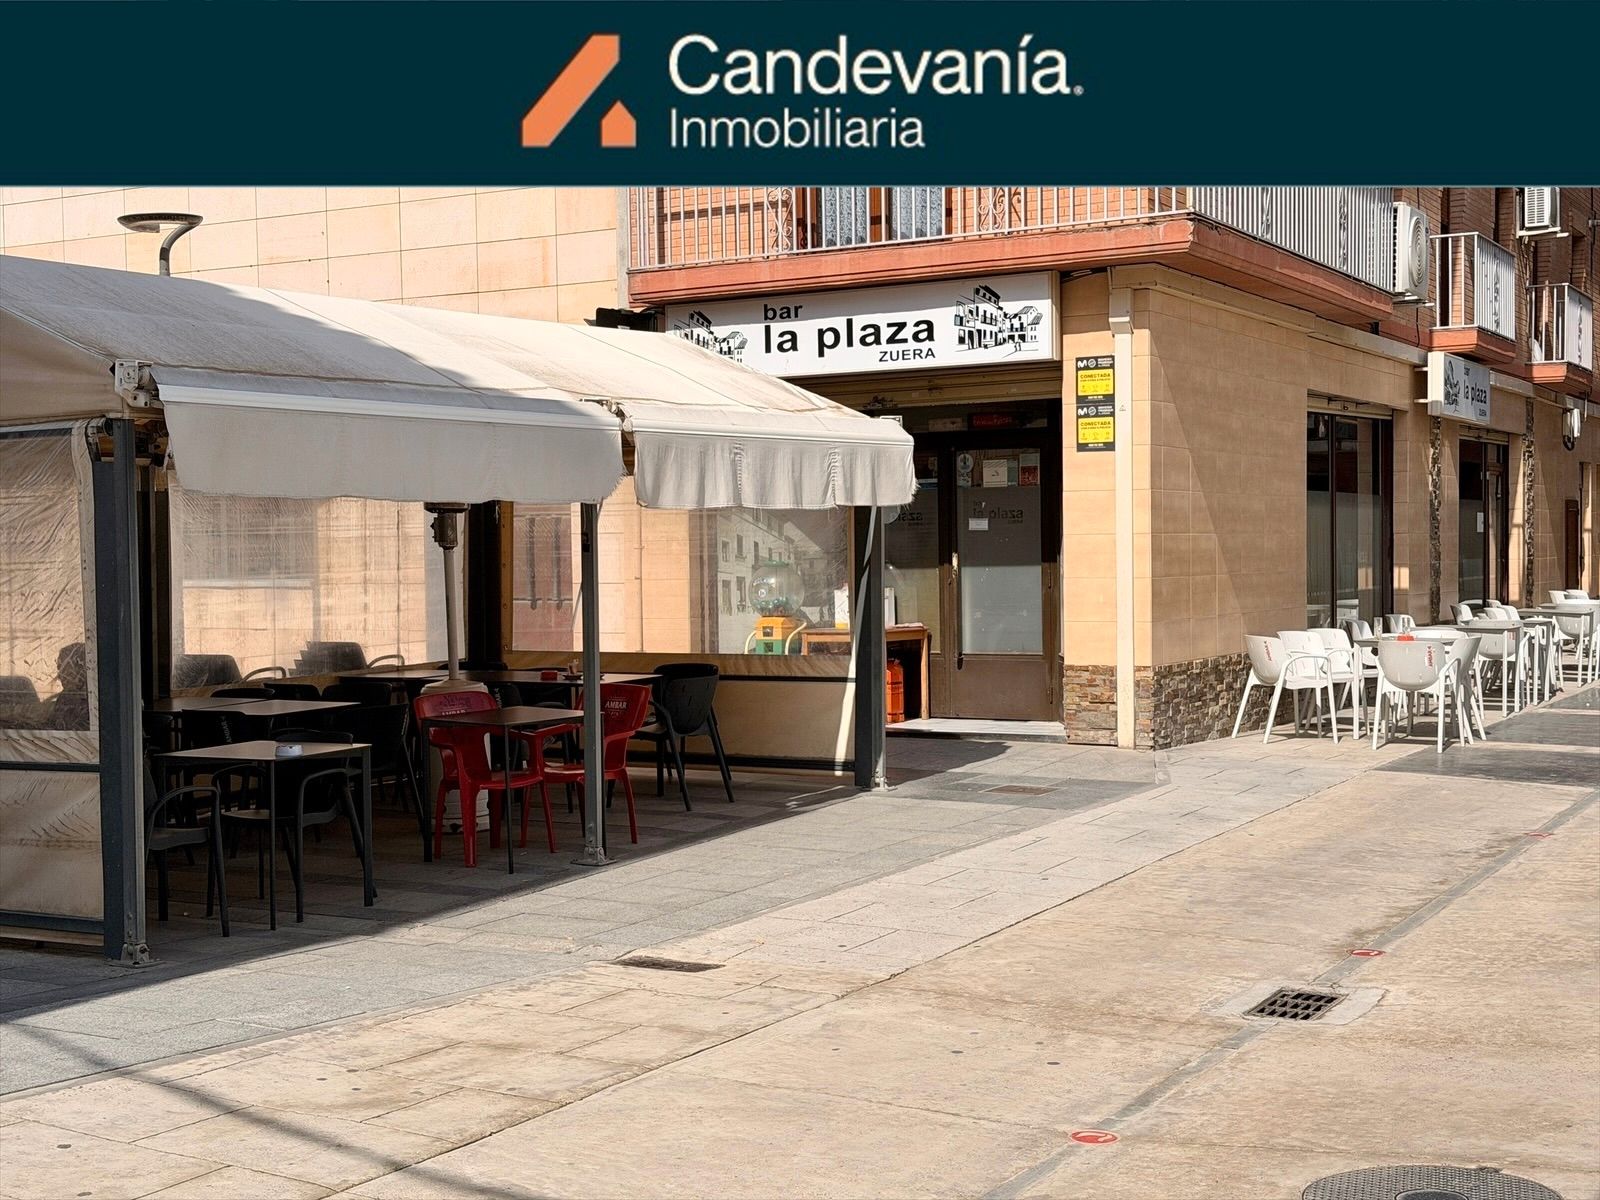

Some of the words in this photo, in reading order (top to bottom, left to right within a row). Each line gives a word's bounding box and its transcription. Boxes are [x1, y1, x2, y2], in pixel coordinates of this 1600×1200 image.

[763, 303, 802, 321] bar
[764, 324, 799, 354] la
[817, 318, 936, 358] plaza
[878, 347, 936, 362] ZUERA
[1464, 380, 1469, 399] la
[1471, 382, 1487, 406] plaza
[604, 701, 627, 709] AMBAR
